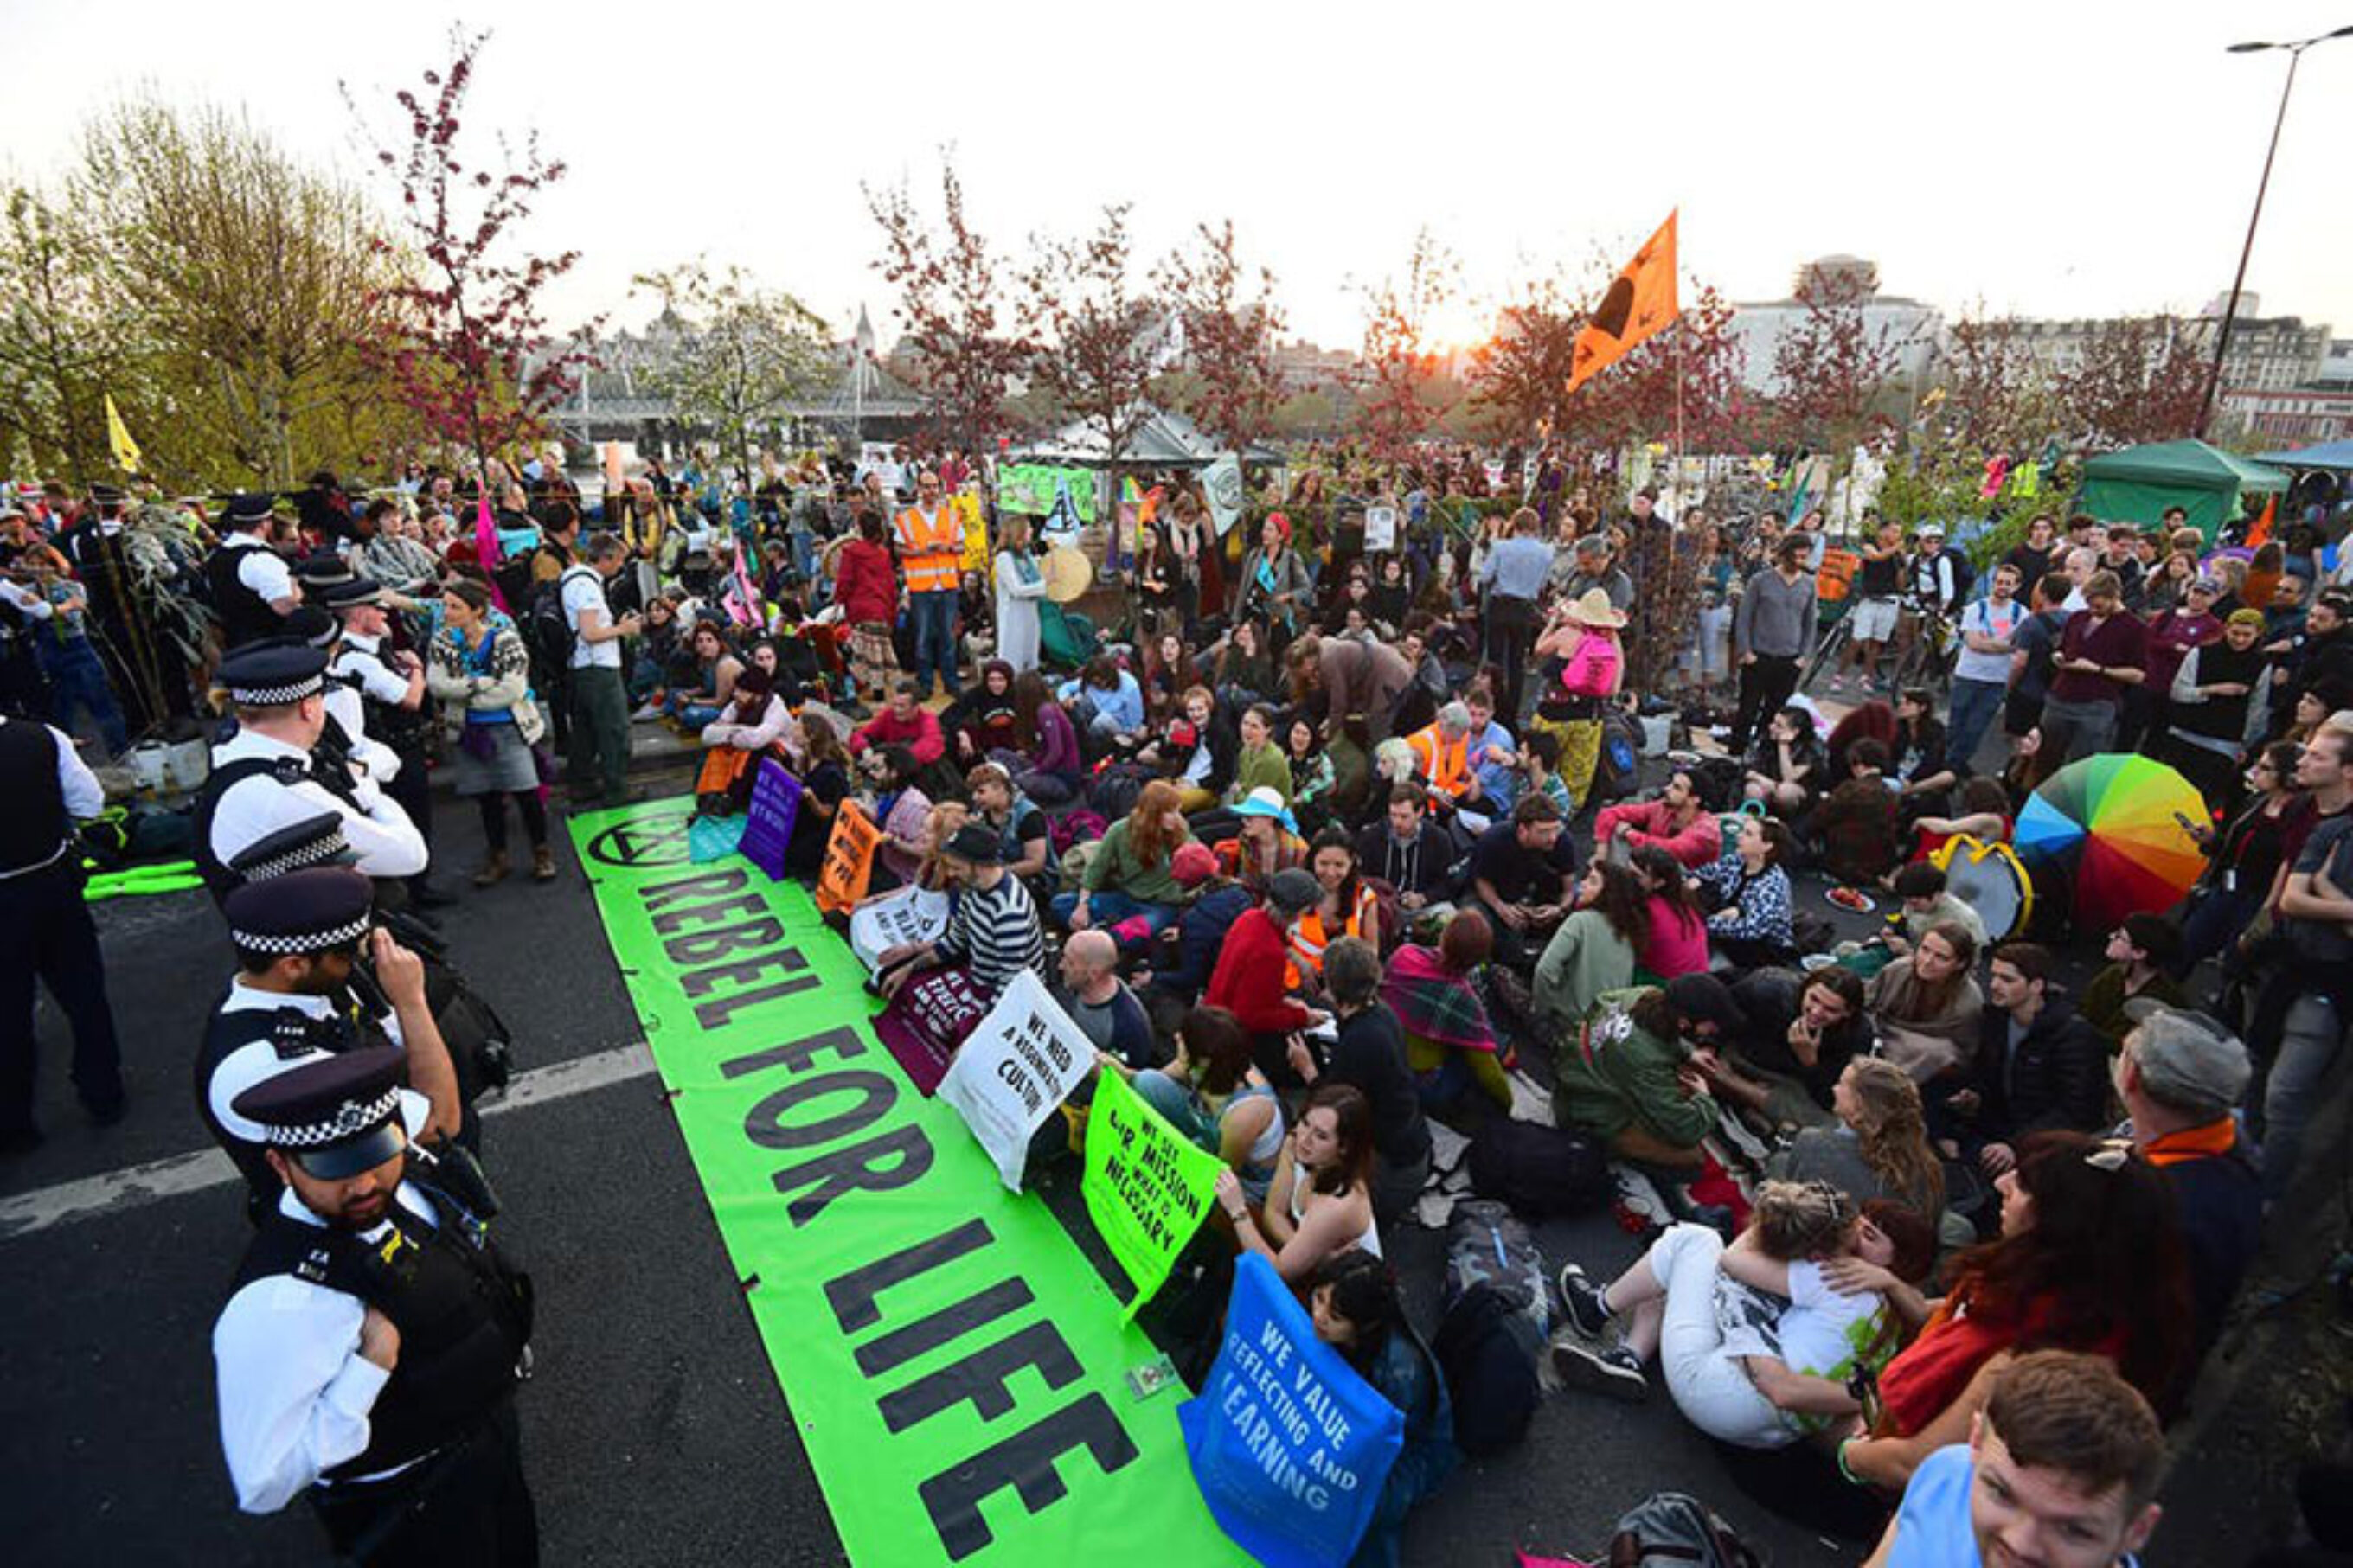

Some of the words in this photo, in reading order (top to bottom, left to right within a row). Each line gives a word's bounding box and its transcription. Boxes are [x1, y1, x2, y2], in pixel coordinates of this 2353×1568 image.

[636, 869, 821, 1030] REBEL
[1001, 1026, 1016, 1041] A
[1027, 1010, 1047, 1042] WE
[1046, 1034, 1073, 1073] NEED
[719, 1023, 935, 1230] FOR
[1143, 1143, 1200, 1220] MISSION
[820, 1217, 1140, 1564] LIFE
[1228, 1332, 1310, 1446] REFLECTING
[1308, 1448, 1357, 1490] AND
[1260, 1319, 1292, 1369] WE
[1296, 1364, 1350, 1451] VALUE
